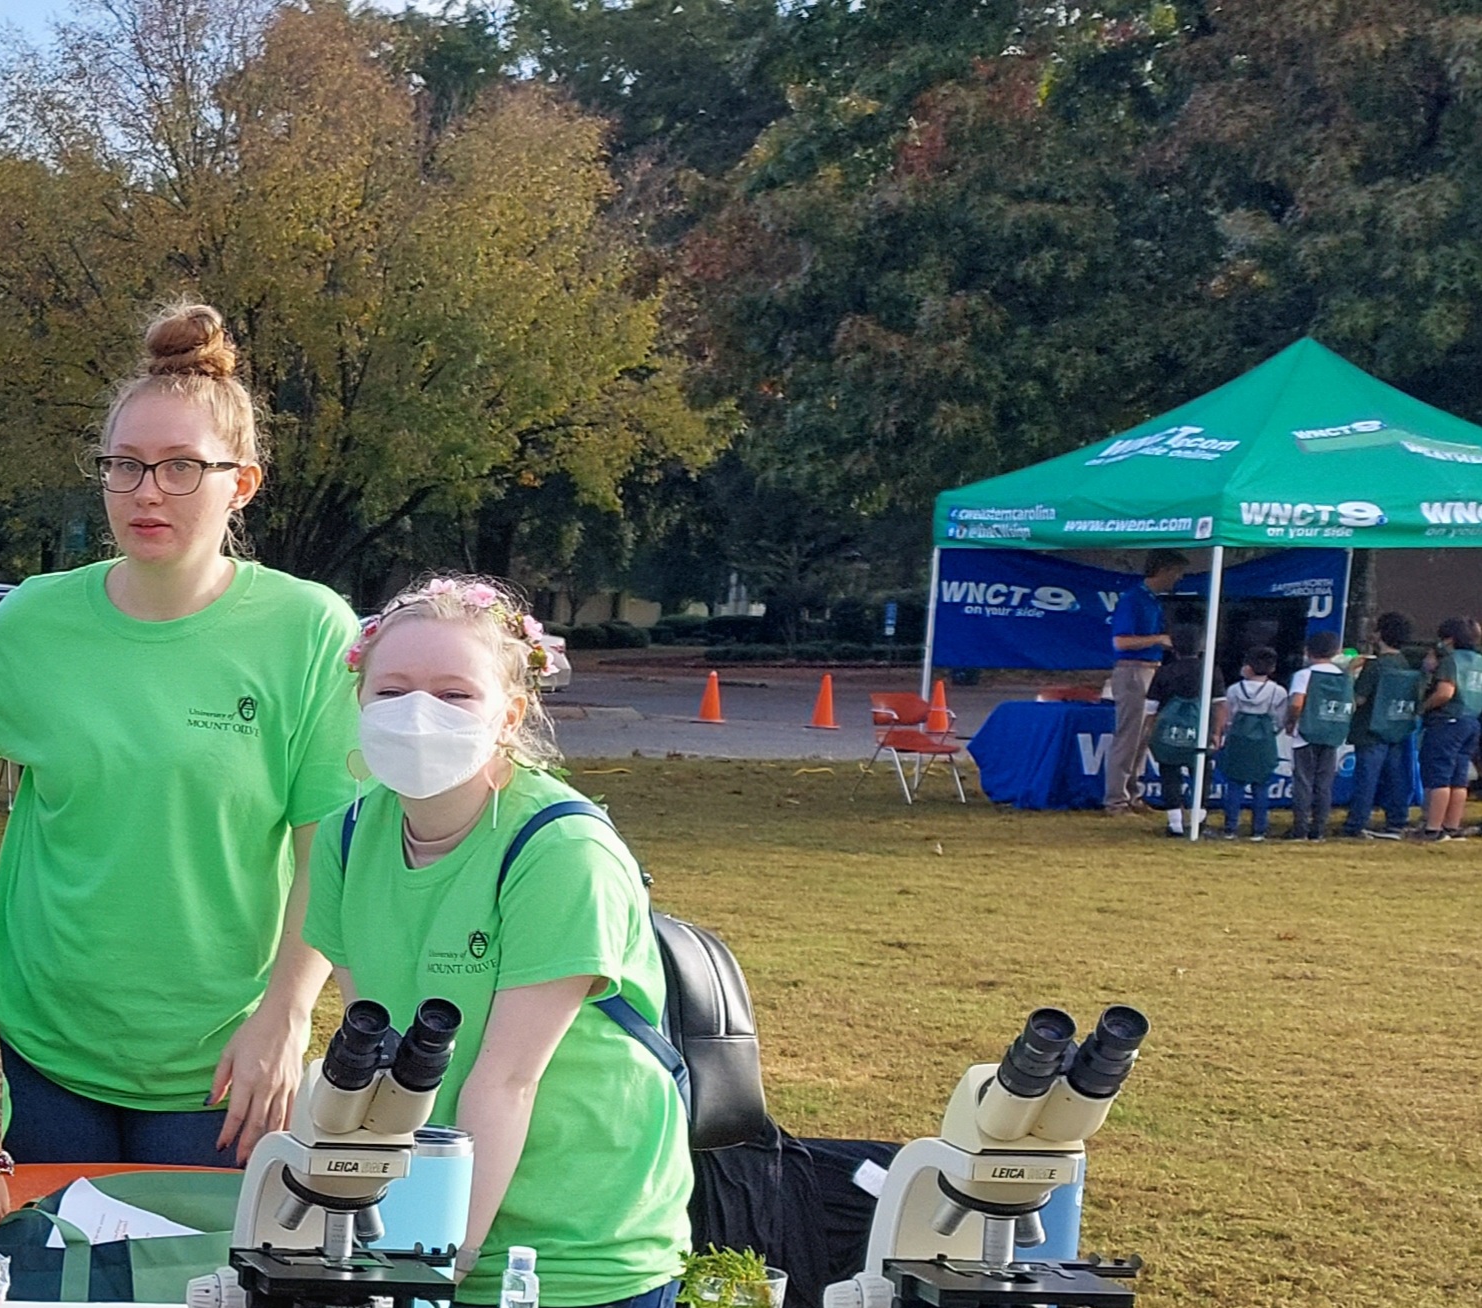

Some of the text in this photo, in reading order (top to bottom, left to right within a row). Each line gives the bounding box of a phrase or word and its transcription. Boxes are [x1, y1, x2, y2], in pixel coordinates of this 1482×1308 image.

[1240, 501, 1385, 527] WNCT9
[327, 1161, 359, 1173] LEICA
[992, 1167, 1025, 1179] LEICA
